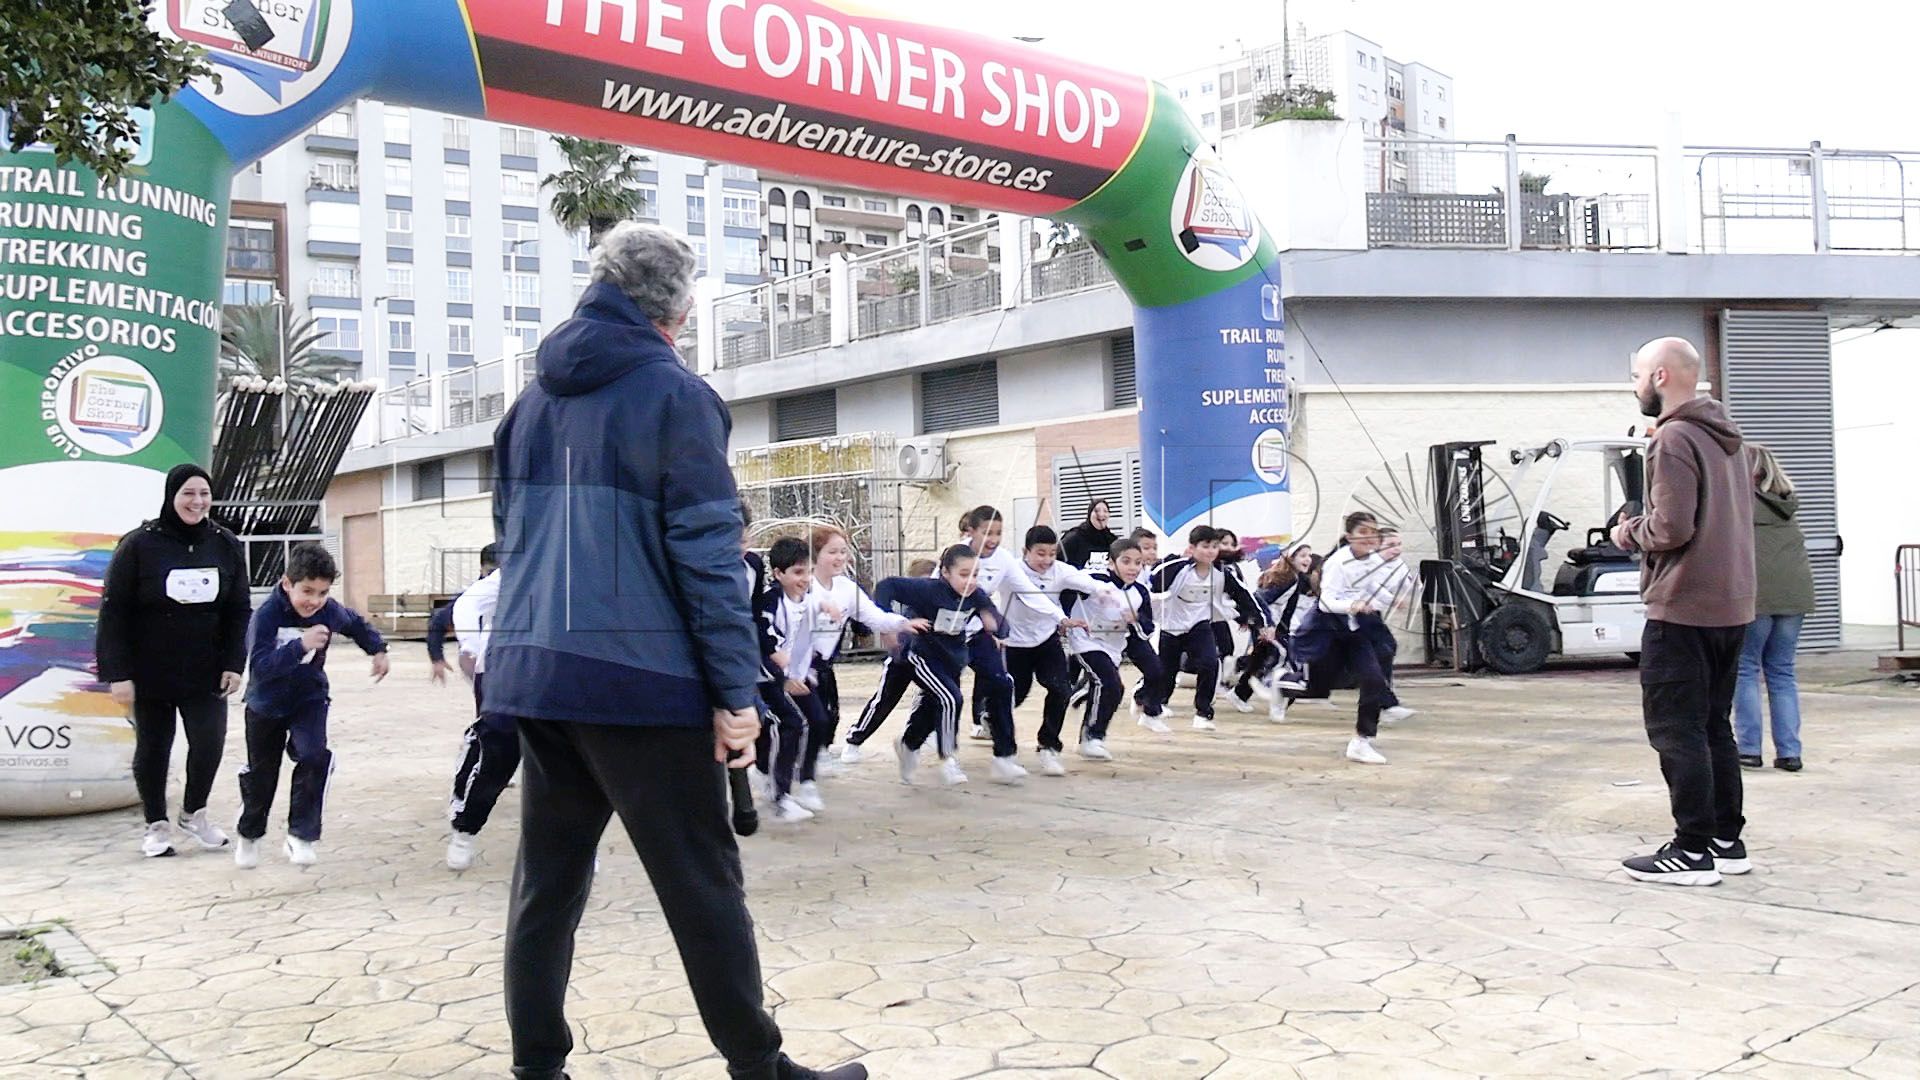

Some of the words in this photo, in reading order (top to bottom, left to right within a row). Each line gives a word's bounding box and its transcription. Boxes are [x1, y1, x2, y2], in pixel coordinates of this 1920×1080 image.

[706, 0, 967, 119] CORNER
[980, 61, 1121, 148] SHOP
[601, 79, 1053, 192] www.adventure-store.es
[0, 166, 84, 197] TRAIL
[0, 202, 142, 240] RUNNING
[0, 274, 220, 332] UPLEMENTACIÓN
[0, 310, 176, 352] CCESORIOS
[1220, 328, 1263, 345] TRAIL
[41, 344, 99, 421] DEPORTIVO
[1202, 388, 1285, 406] SUPLEMENT
[46, 424, 82, 459] CLUB
